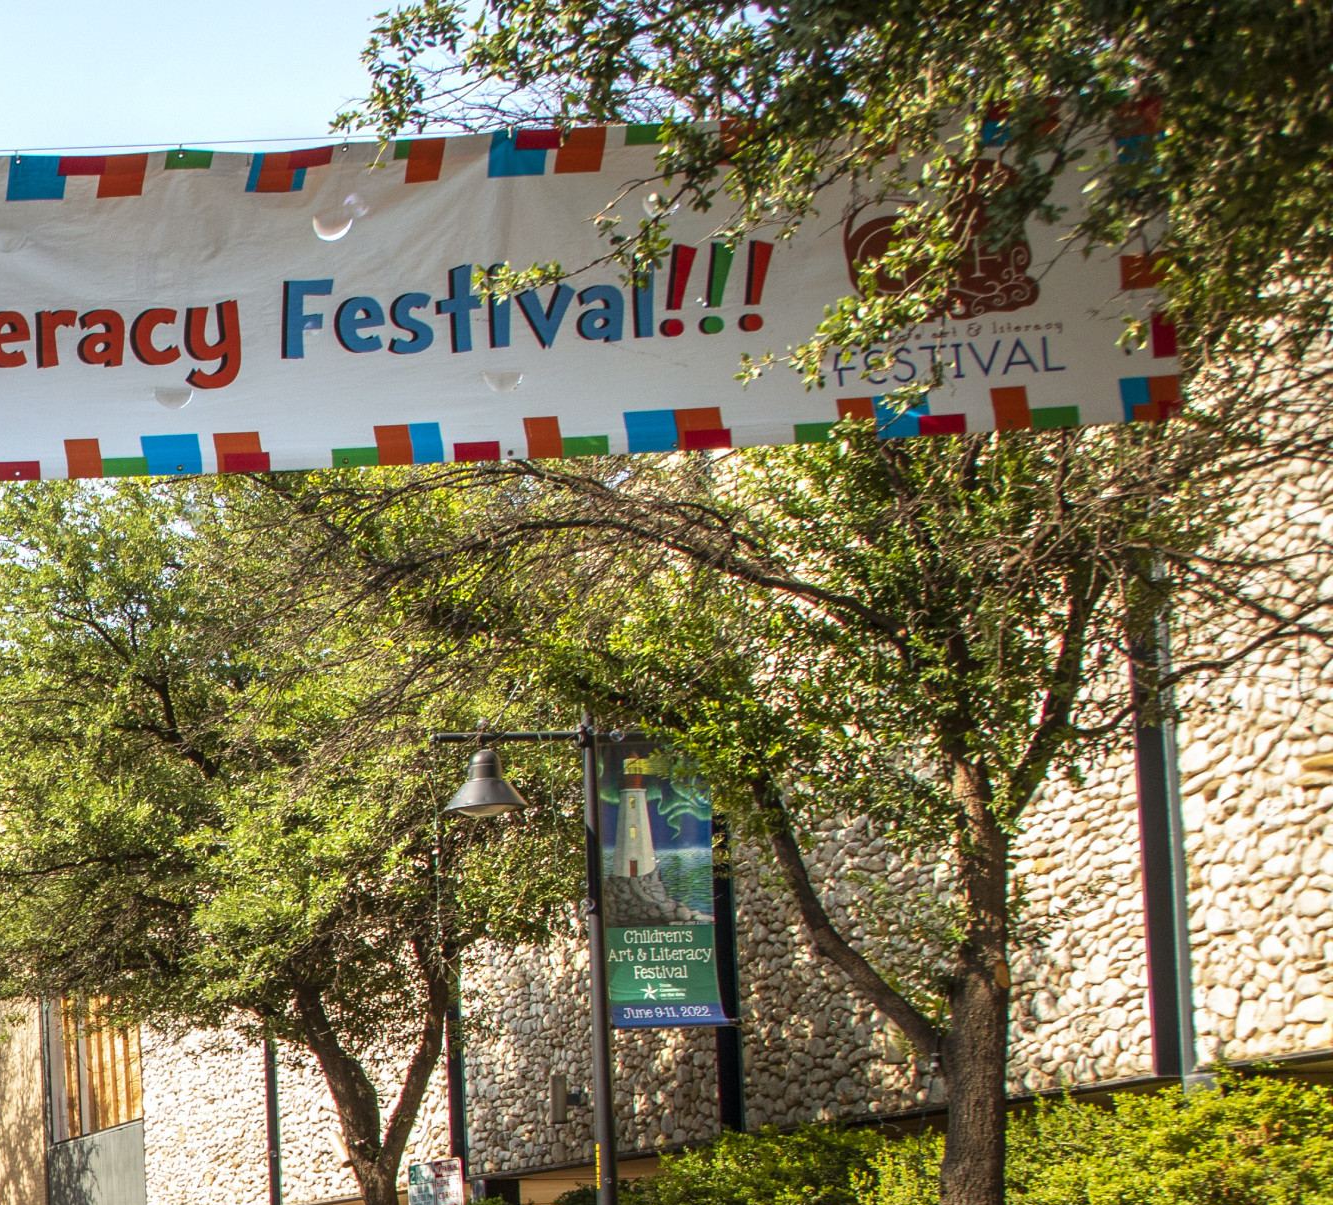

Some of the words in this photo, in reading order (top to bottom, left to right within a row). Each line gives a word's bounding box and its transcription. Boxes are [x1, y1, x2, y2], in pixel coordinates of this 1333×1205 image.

[281, 240, 774, 360] Festival!!!
[833, 335, 1067, 387] FESTIVAL
[623, 930, 693, 944] Children's
[608, 948, 634, 962] Art
[637, 948, 647, 961] &
[650, 947, 712, 963] Literacy
[633, 965, 688, 980] Festival
[623, 1006, 653, 1019] June
[680, 1005, 712, 1017] 2022
